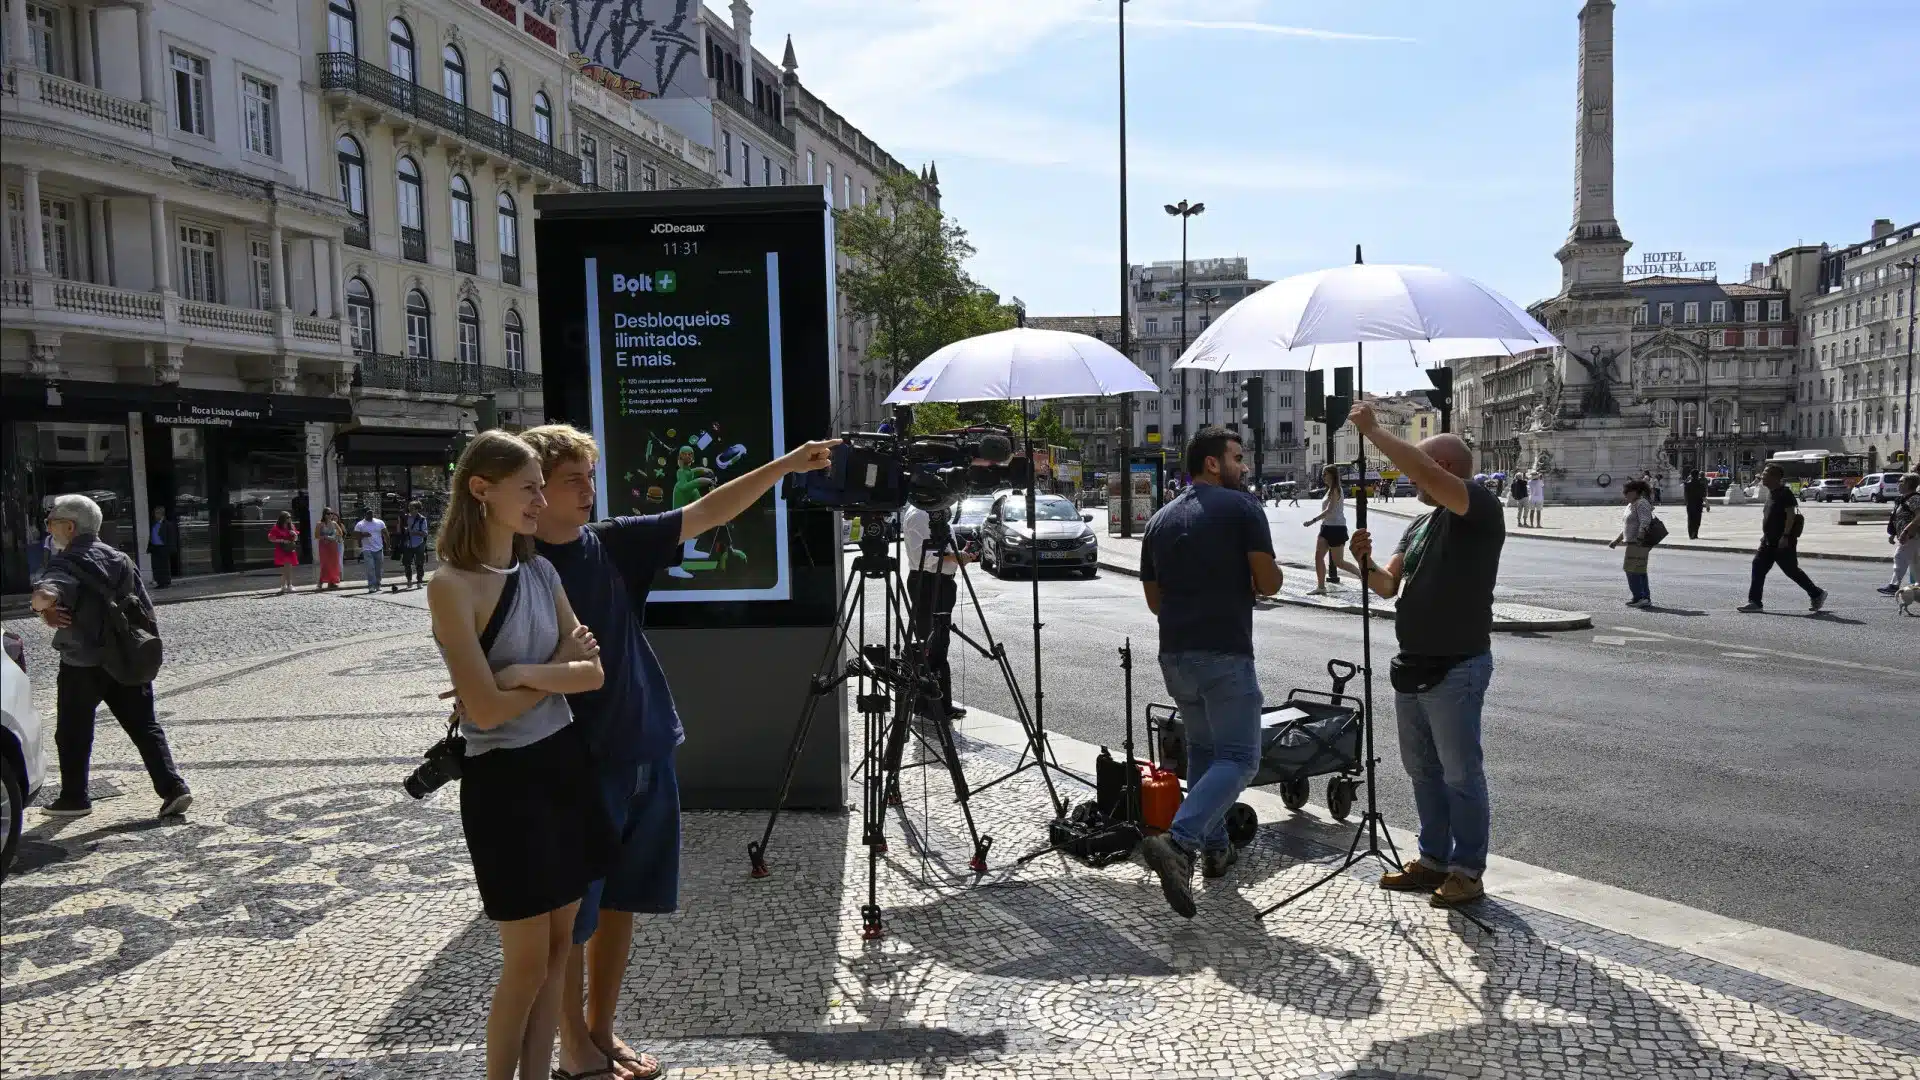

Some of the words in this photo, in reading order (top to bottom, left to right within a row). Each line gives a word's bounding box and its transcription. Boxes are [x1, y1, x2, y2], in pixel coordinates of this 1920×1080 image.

[650, 223, 705, 234] JCDecaux
[1643, 252, 1686, 263] HOTEL
[1624, 264, 1665, 275] ENIDA
[1669, 262, 1717, 273] PALACE
[612, 273, 653, 298] Bolt
[614, 310, 730, 330] Desbloqueios
[615, 331, 702, 348] ilimitados.
[616, 351, 627, 367] E
[631, 350, 676, 367] mais.
[191, 405, 210, 415] Roca
[211, 407, 235, 416] Lisboa
[235, 409, 260, 419] Gallery
[155, 415, 178, 424] Roca
[179, 415, 205, 425] Lisboa
[206, 416, 233, 427] Gallery
